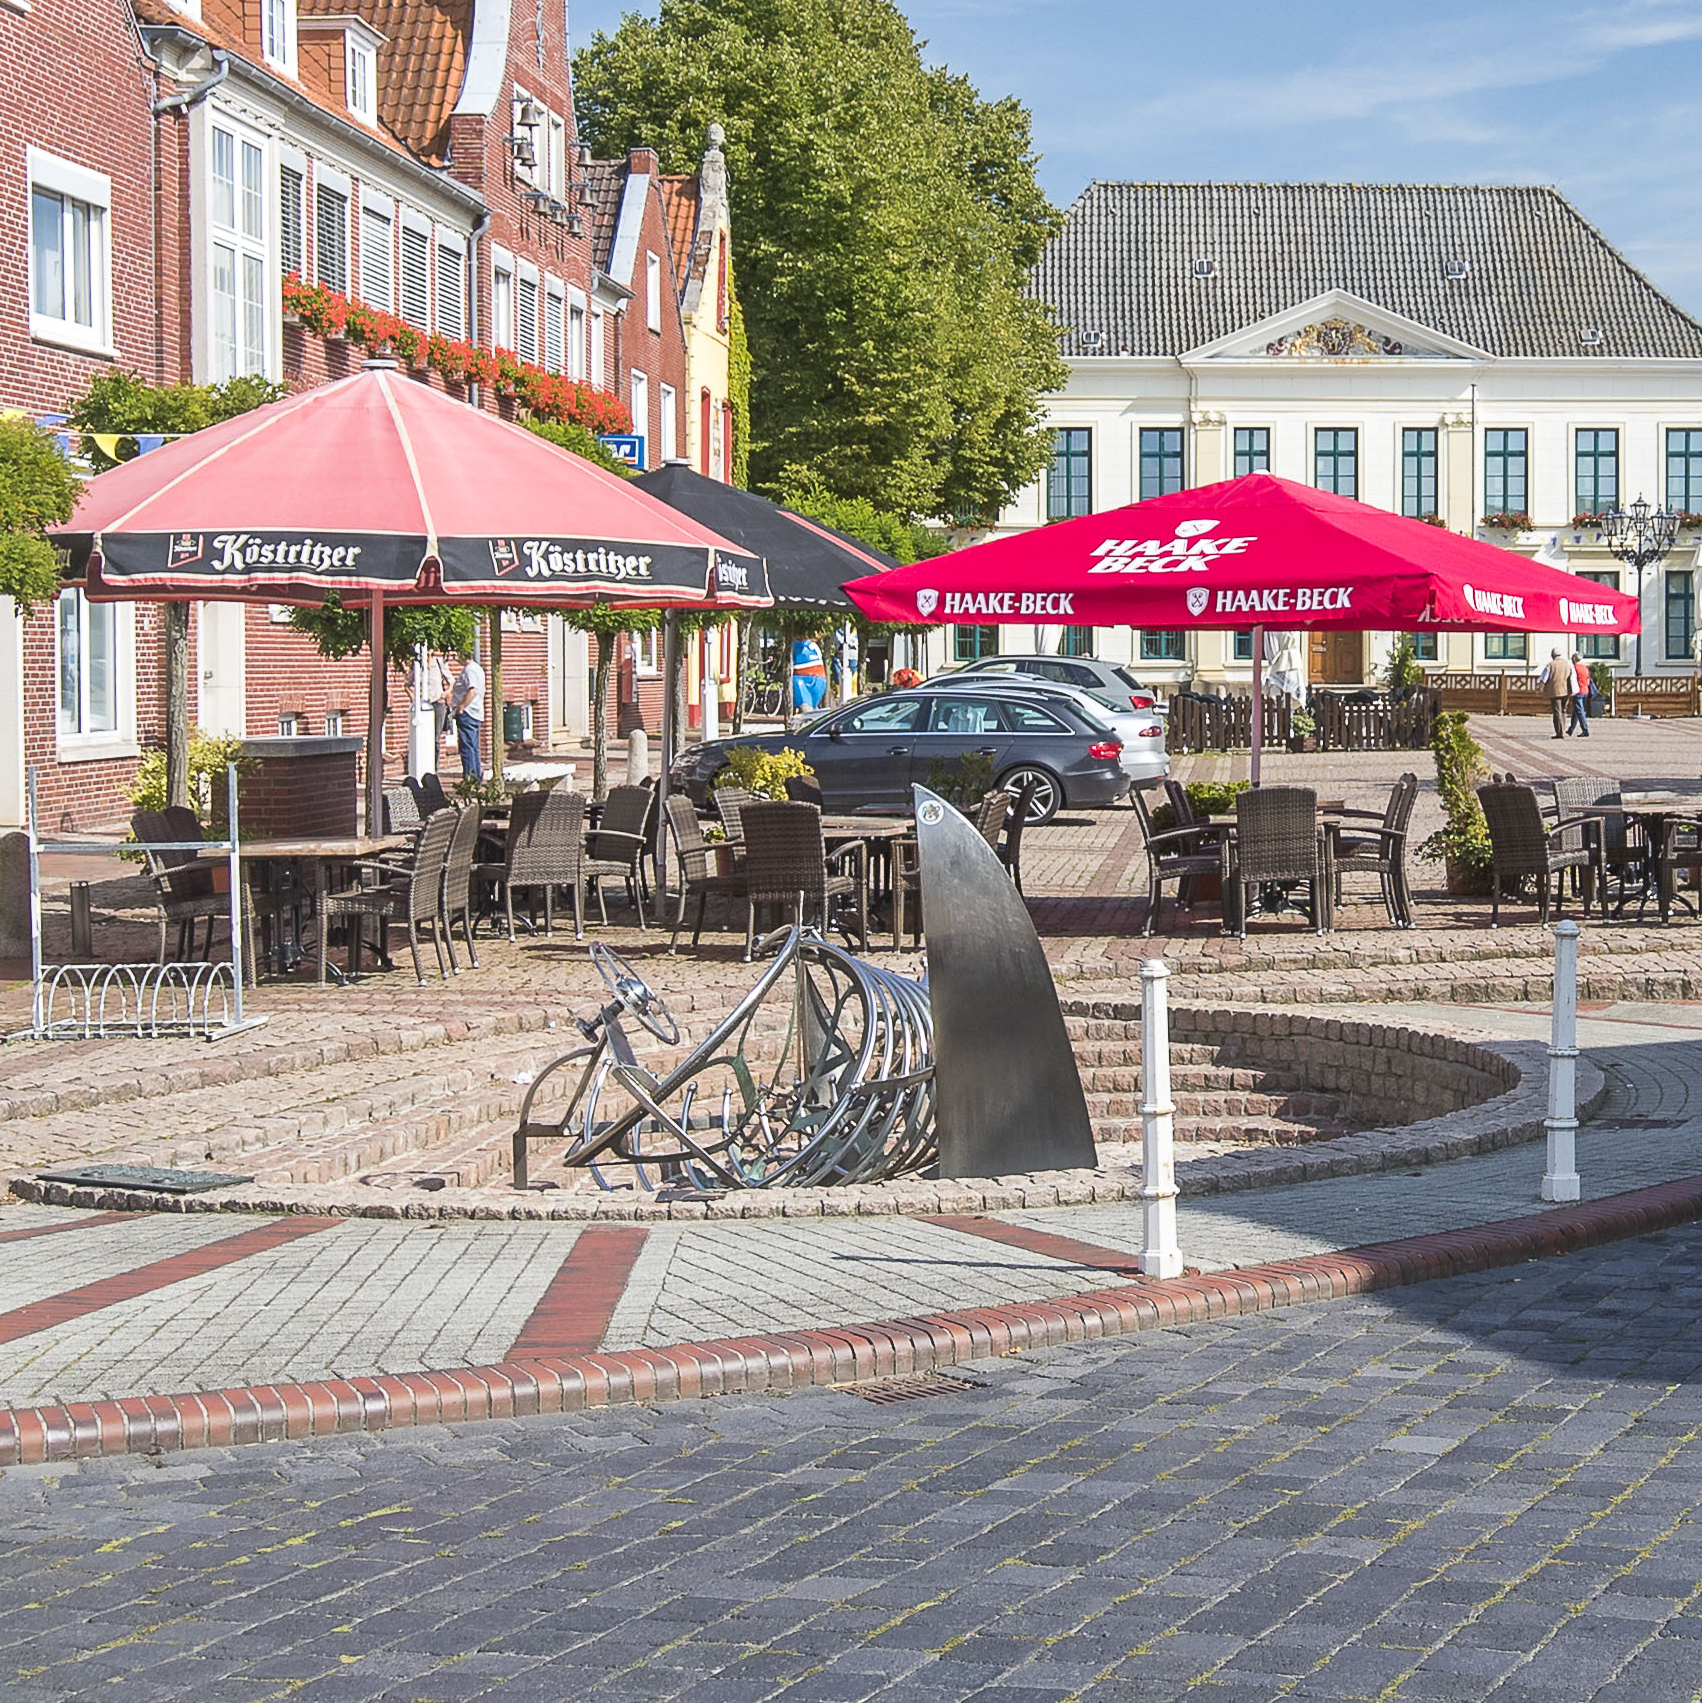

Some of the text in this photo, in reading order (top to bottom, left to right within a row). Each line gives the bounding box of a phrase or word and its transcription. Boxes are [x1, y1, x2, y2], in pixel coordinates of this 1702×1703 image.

[210, 533, 362, 572] Köstritzer
[1087, 536, 1259, 557] HAAKE
[522, 540, 653, 580] Köstritzer
[1087, 555, 1222, 574] BECK
[943, 592, 1075, 615] HAAKE-BECK
[1216, 587, 1354, 613] HAAKE-BECK
[1474, 589, 1526, 619] HAAKE-BECK
[1568, 602, 1619, 625] HAAKE-BECK
